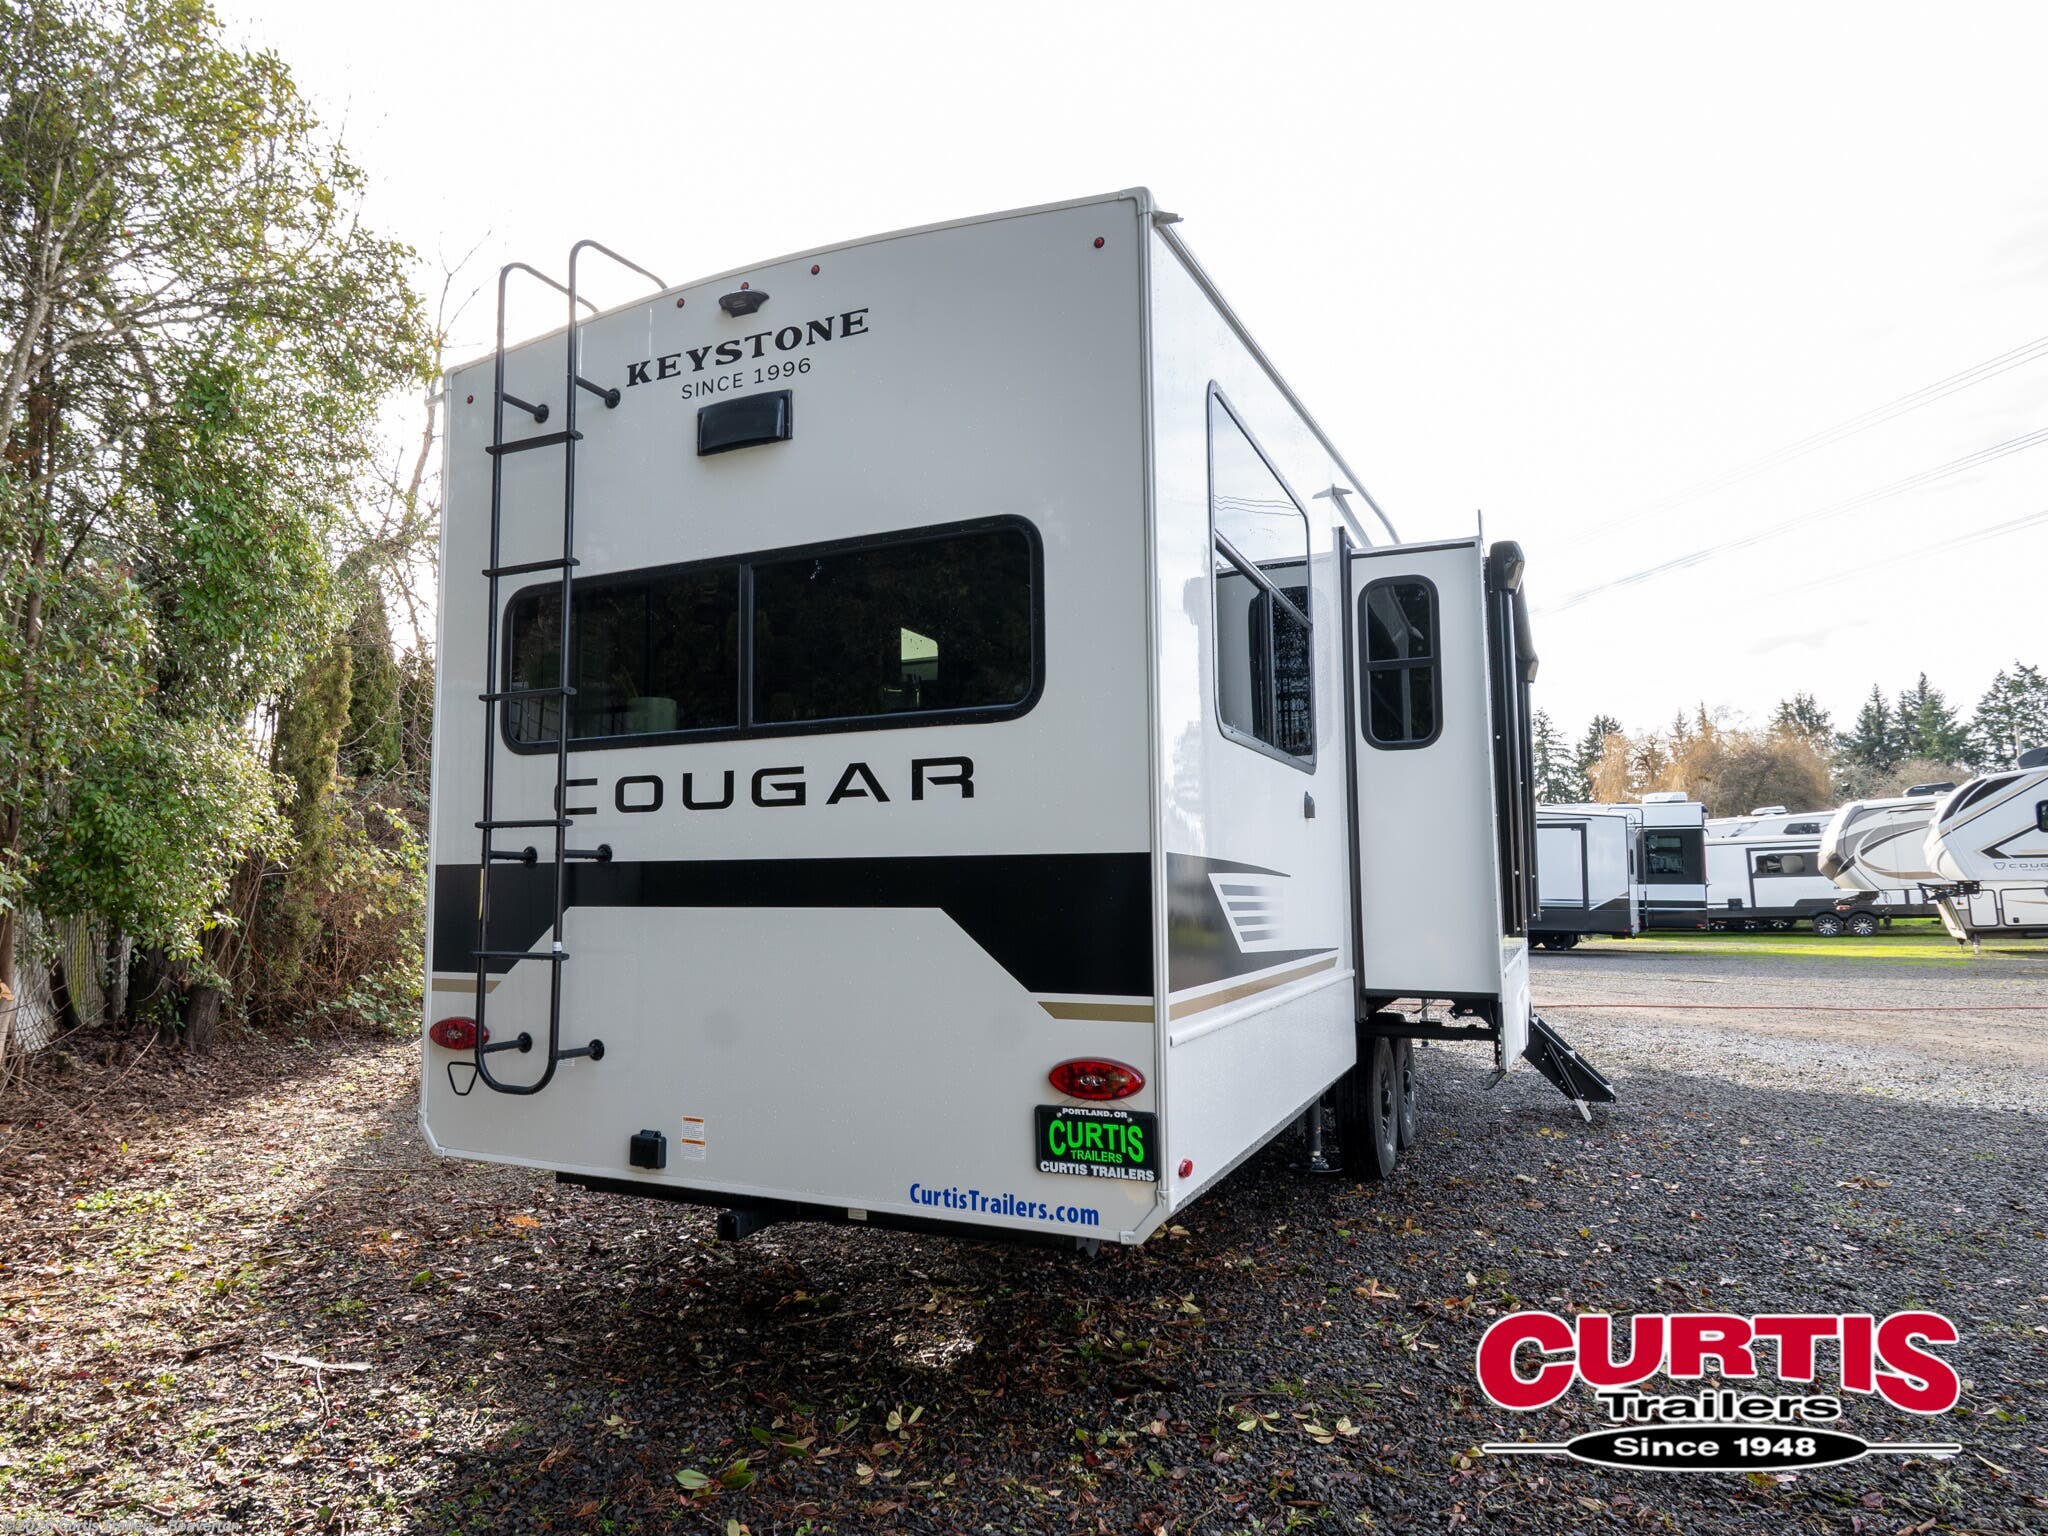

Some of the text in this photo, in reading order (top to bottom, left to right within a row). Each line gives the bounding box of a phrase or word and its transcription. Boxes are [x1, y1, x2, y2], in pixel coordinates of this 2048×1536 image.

[626, 308, 869, 387] KEYSTONE
[681, 357, 811, 400] SINCE 1996
[554, 755, 975, 816] COUGAR
[1114, 1111, 1128, 1119] OR
[1049, 1120, 1145, 1163] CURTIS
[1071, 1150, 1123, 1163] TRAILERS
[1040, 1161, 1155, 1182] CURTIS TRAILERS
[910, 1183, 1100, 1226] CurtisTrailers.com
